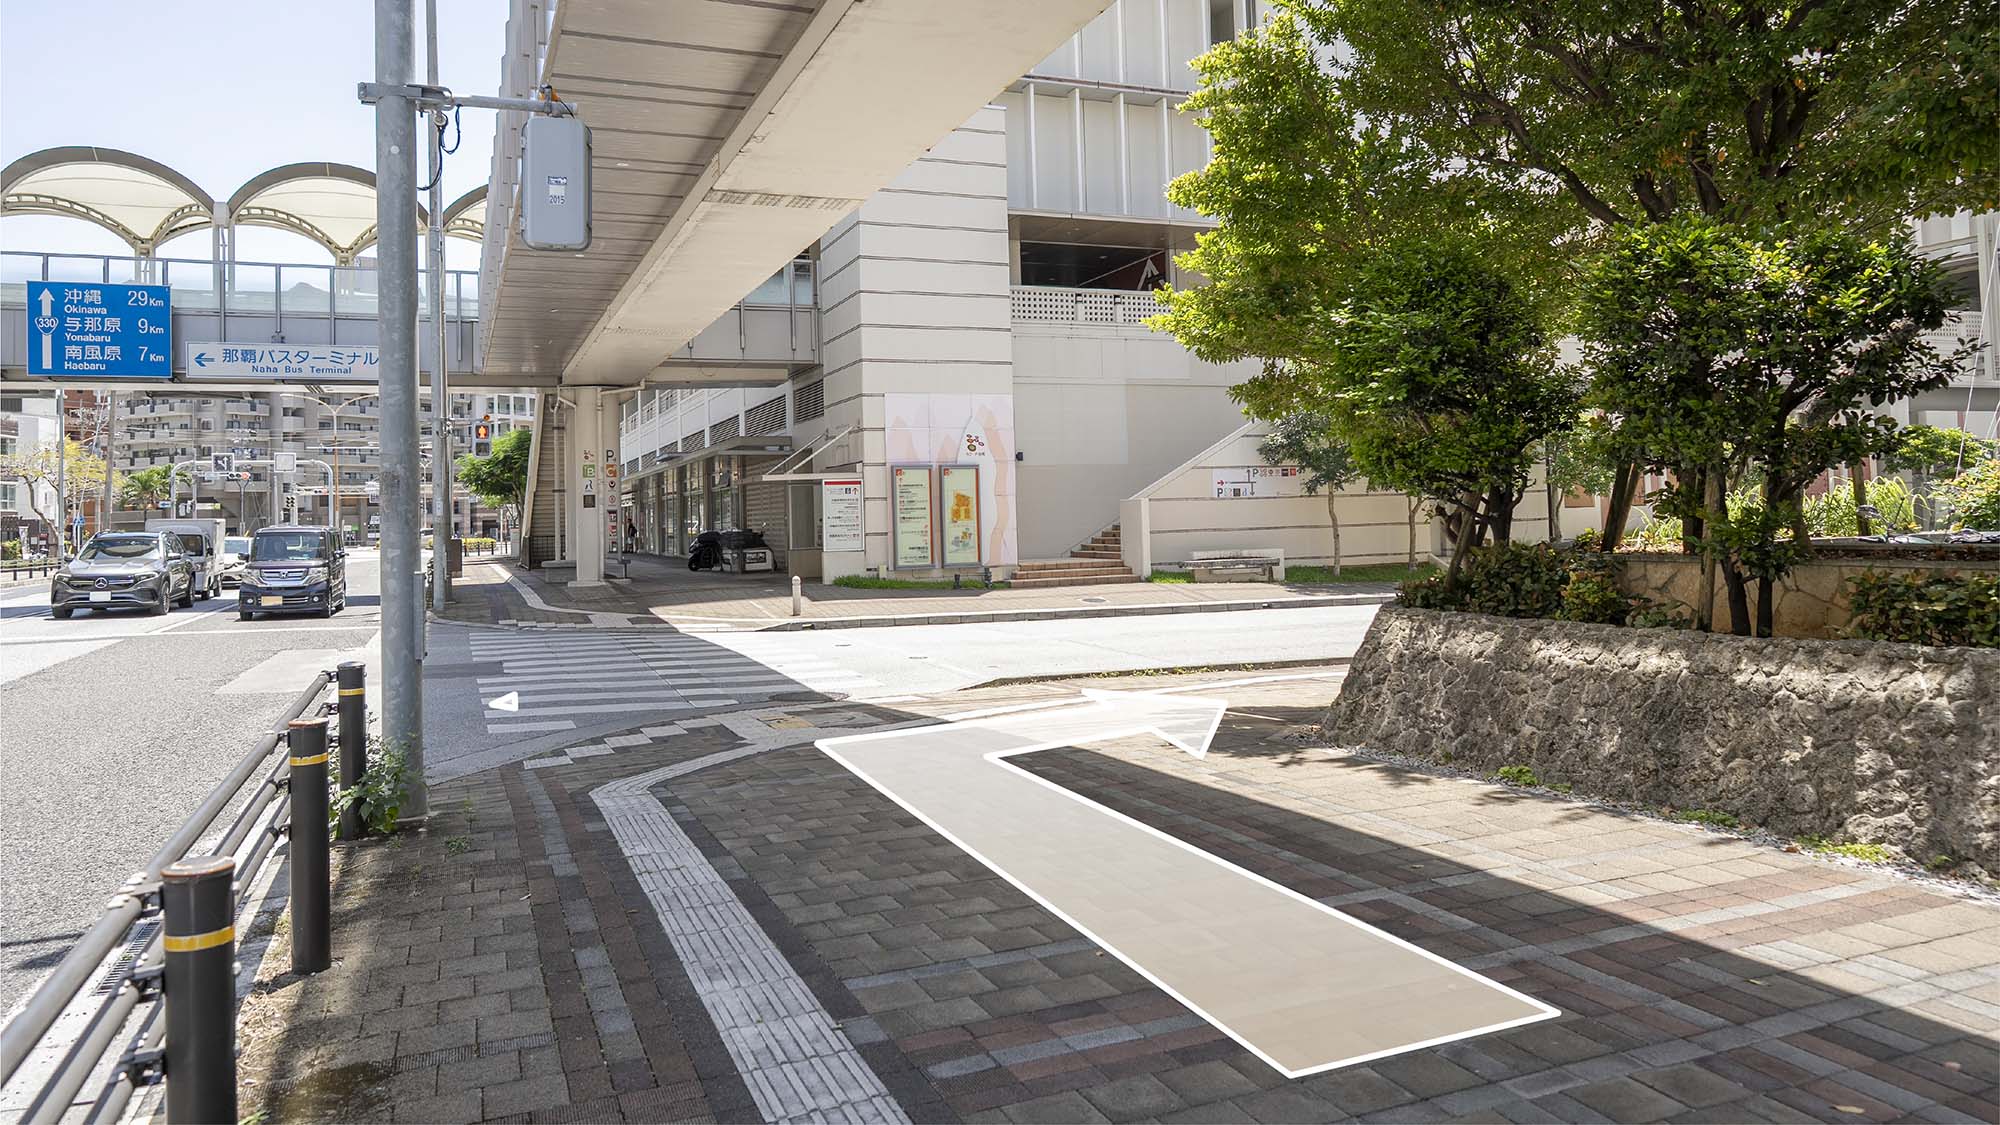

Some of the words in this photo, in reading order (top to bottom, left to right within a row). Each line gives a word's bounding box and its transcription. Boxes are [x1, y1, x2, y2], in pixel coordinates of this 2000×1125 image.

[550, 195, 565, 204] 2015
[64, 288, 102, 304] 沖縄
[64, 305, 107, 315] Okinawa
[38, 318, 56, 328] 330
[64, 317, 122, 333] 与那原
[64, 332, 111, 342] Yonabaru
[64, 345, 122, 361] 南風原
[222, 348, 379, 366] 那覇バスターミナル
[64, 361, 106, 370] Haebaru
[251, 365, 278, 374] Naha
[284, 365, 303, 374] Bus
[309, 365, 352, 375] Terminal
